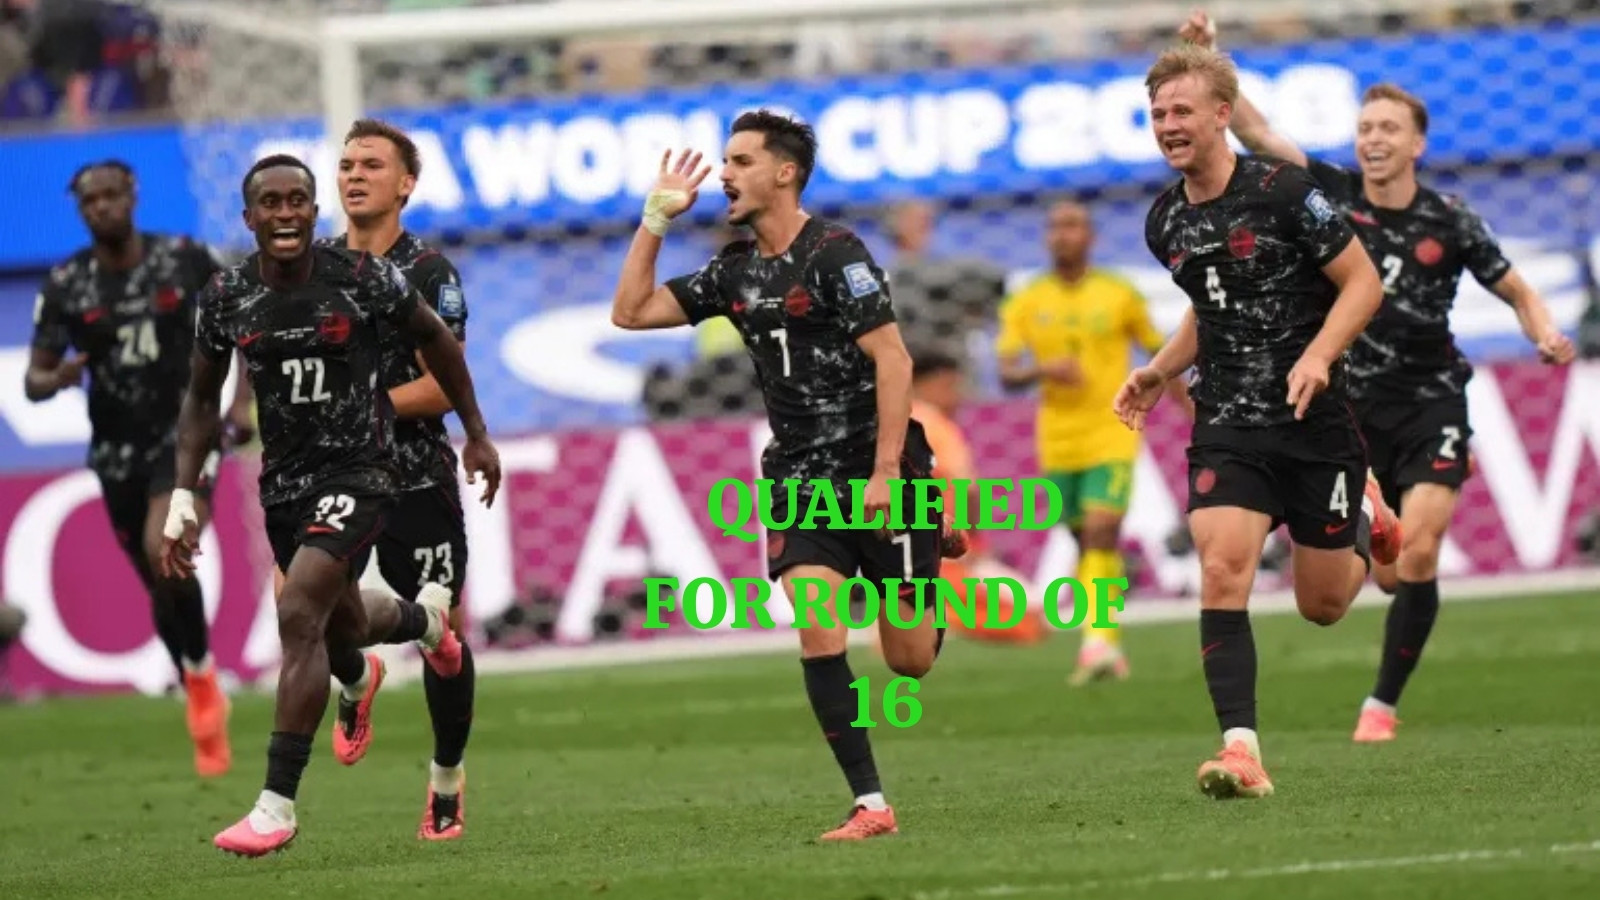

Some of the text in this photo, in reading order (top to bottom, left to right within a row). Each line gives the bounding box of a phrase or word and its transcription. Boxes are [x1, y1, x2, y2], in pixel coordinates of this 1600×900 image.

[461, 104, 805, 209] WORL
[816, 87, 1009, 182] CUP
[1205, 265, 1227, 309] 4
[1381, 253, 1403, 295] 2
[116, 318, 159, 367] 24
[769, 327, 791, 377] 7
[281, 356, 332, 405] 22
[1438, 425, 1461, 460] 2
[1329, 470, 1350, 519] 4
[413, 541, 455, 588] 23
